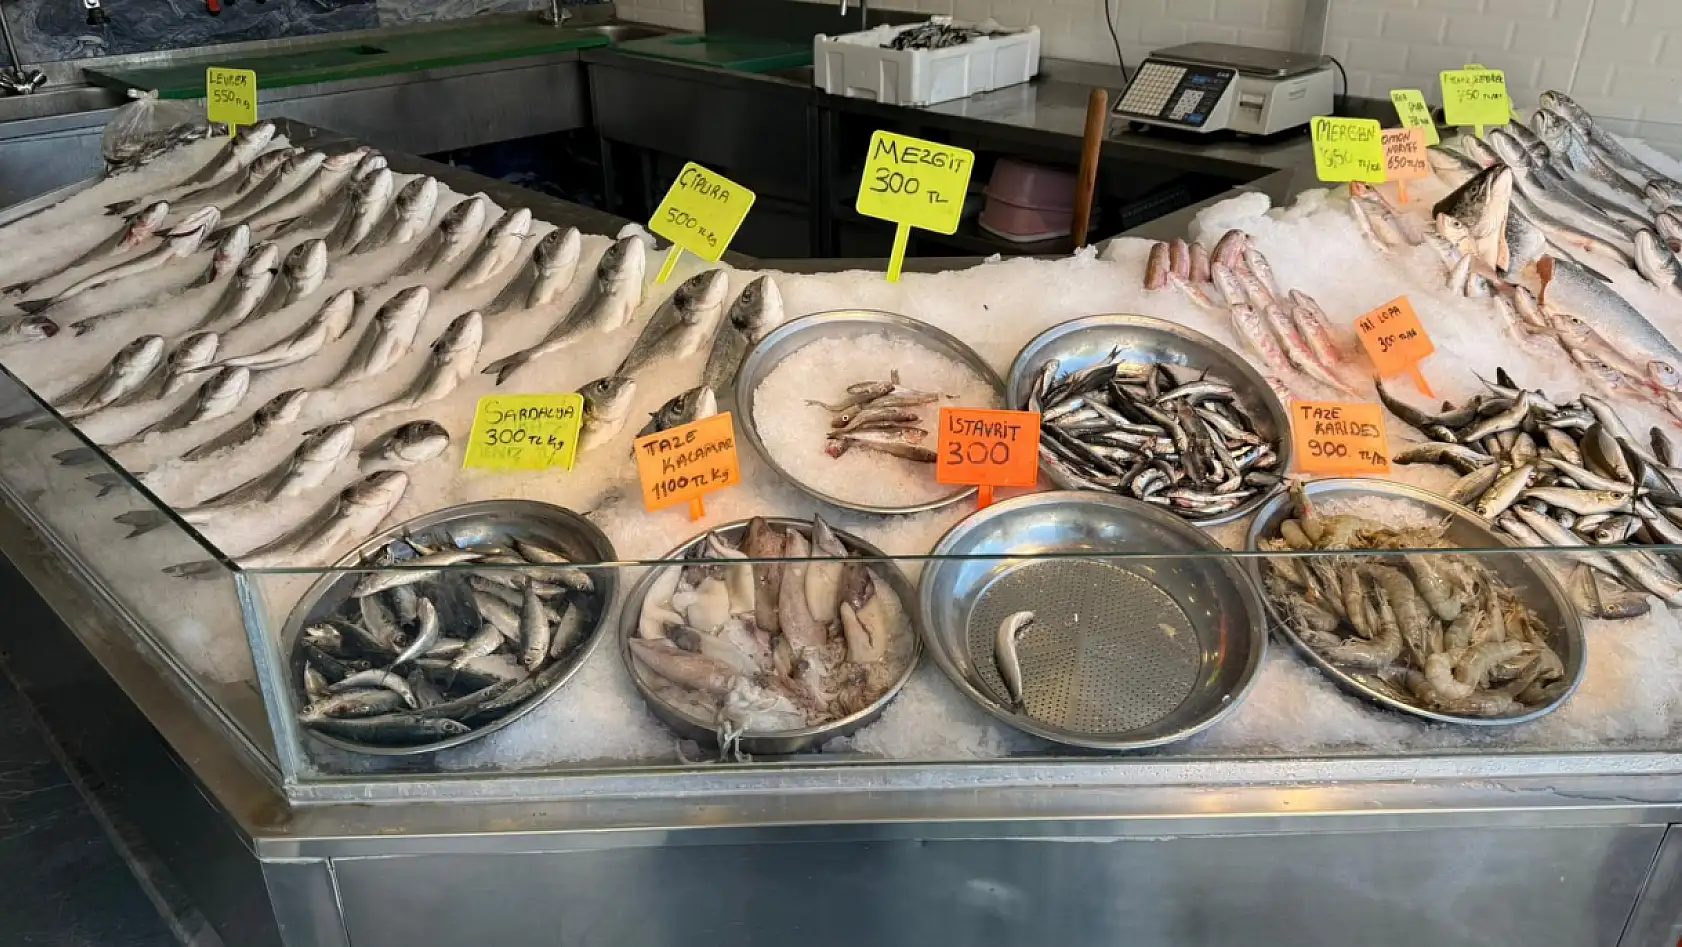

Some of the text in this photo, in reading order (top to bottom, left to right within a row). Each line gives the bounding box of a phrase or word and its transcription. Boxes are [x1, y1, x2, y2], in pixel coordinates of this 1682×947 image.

[213, 89, 236, 103] 550
[1316, 119, 1376, 142] MERCAN
[1381, 130, 1411, 146] OMON
[1387, 156, 1407, 171] 650
[869, 166, 949, 204] 300 TL
[665, 207, 698, 229] 500
[1377, 334, 1397, 353] 300
[484, 400, 575, 426] SARDALYA
[1301, 405, 1343, 420] TAZE
[484, 428, 526, 447] 300
[527, 434, 543, 446] TL
[642, 428, 698, 456] TAZE
[1307, 438, 1348, 458] 900
[946, 441, 1009, 465] 300
[651, 475, 689, 501] 1100
[691, 474, 709, 488] TL
